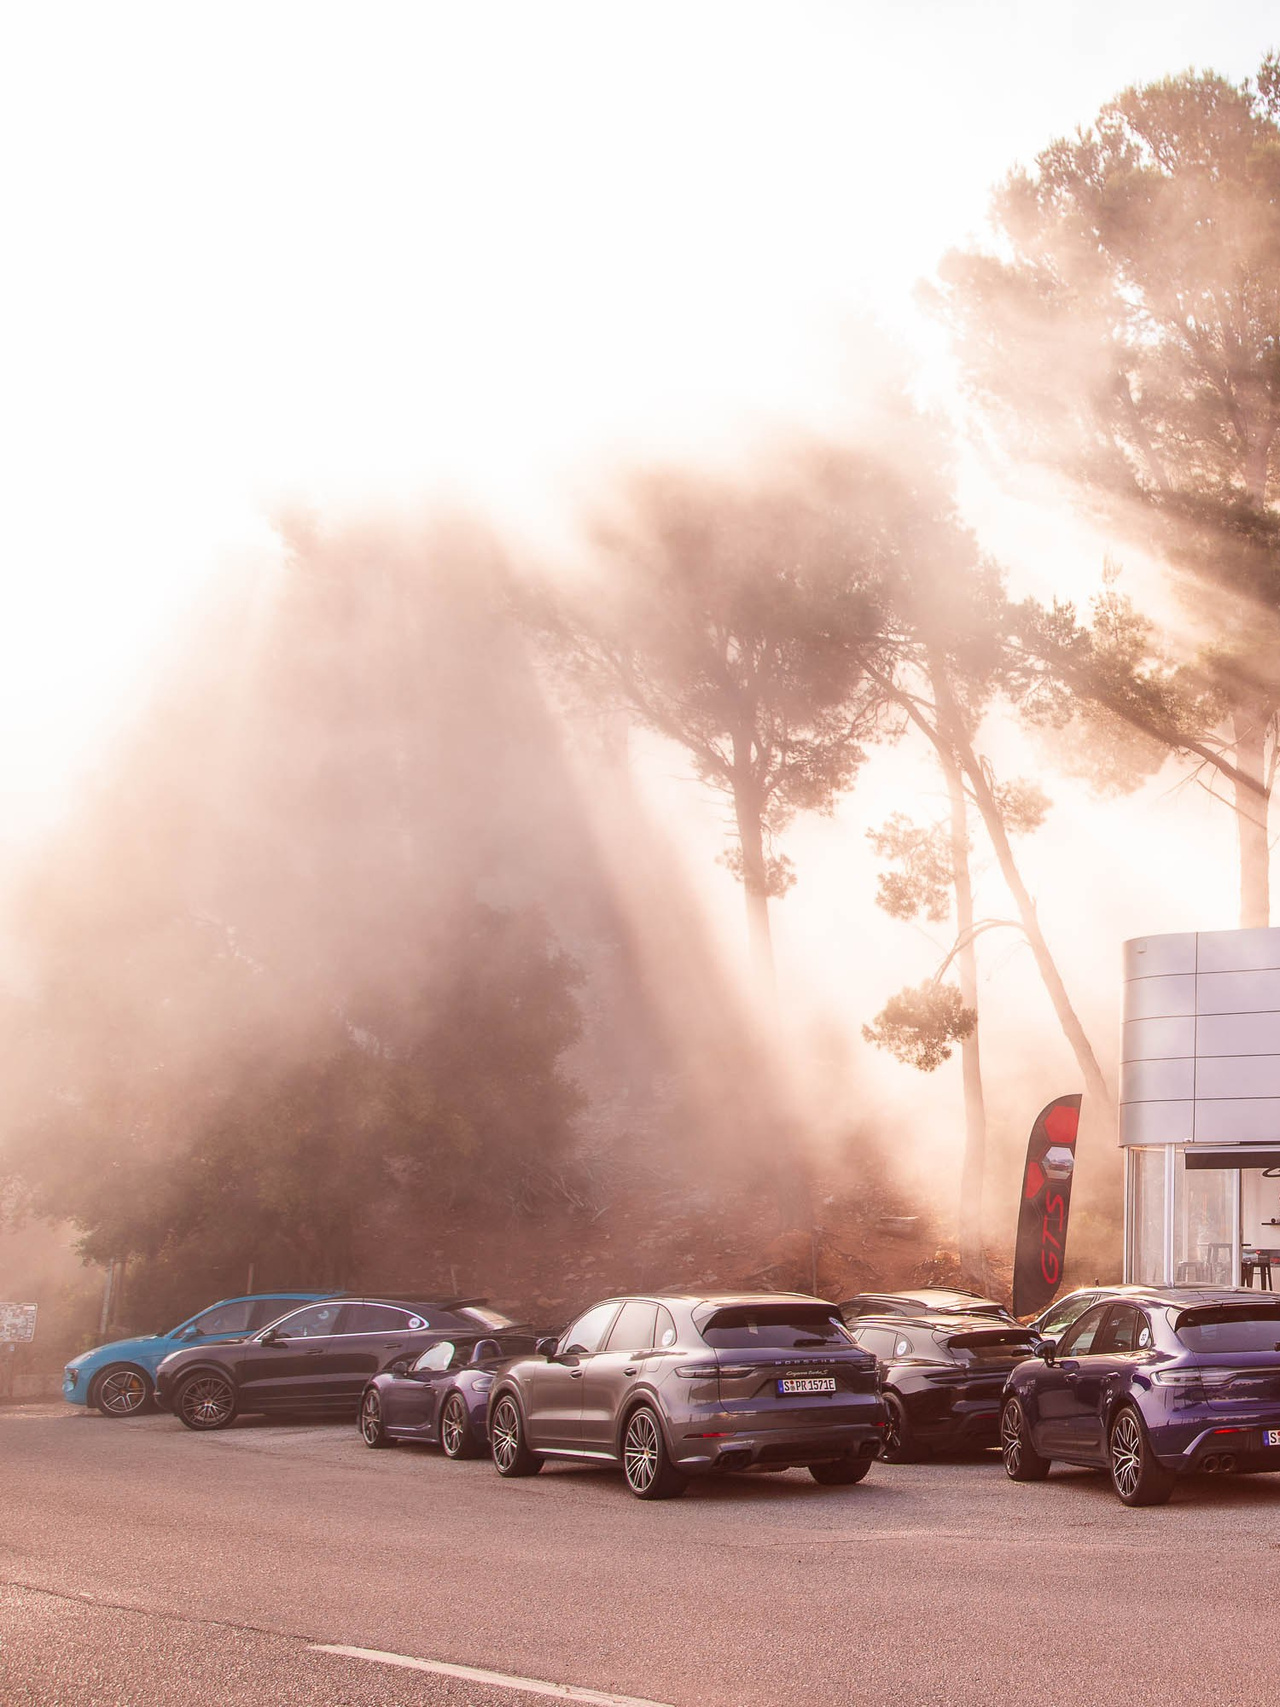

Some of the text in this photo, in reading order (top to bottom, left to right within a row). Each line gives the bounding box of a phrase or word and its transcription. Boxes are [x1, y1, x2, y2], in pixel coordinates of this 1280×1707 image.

[1040, 1189, 1065, 1285] GTS
[784, 1381, 790, 1391] S
[796, 1380, 807, 1391] PR
[1270, 1432, 1278, 1444] S
